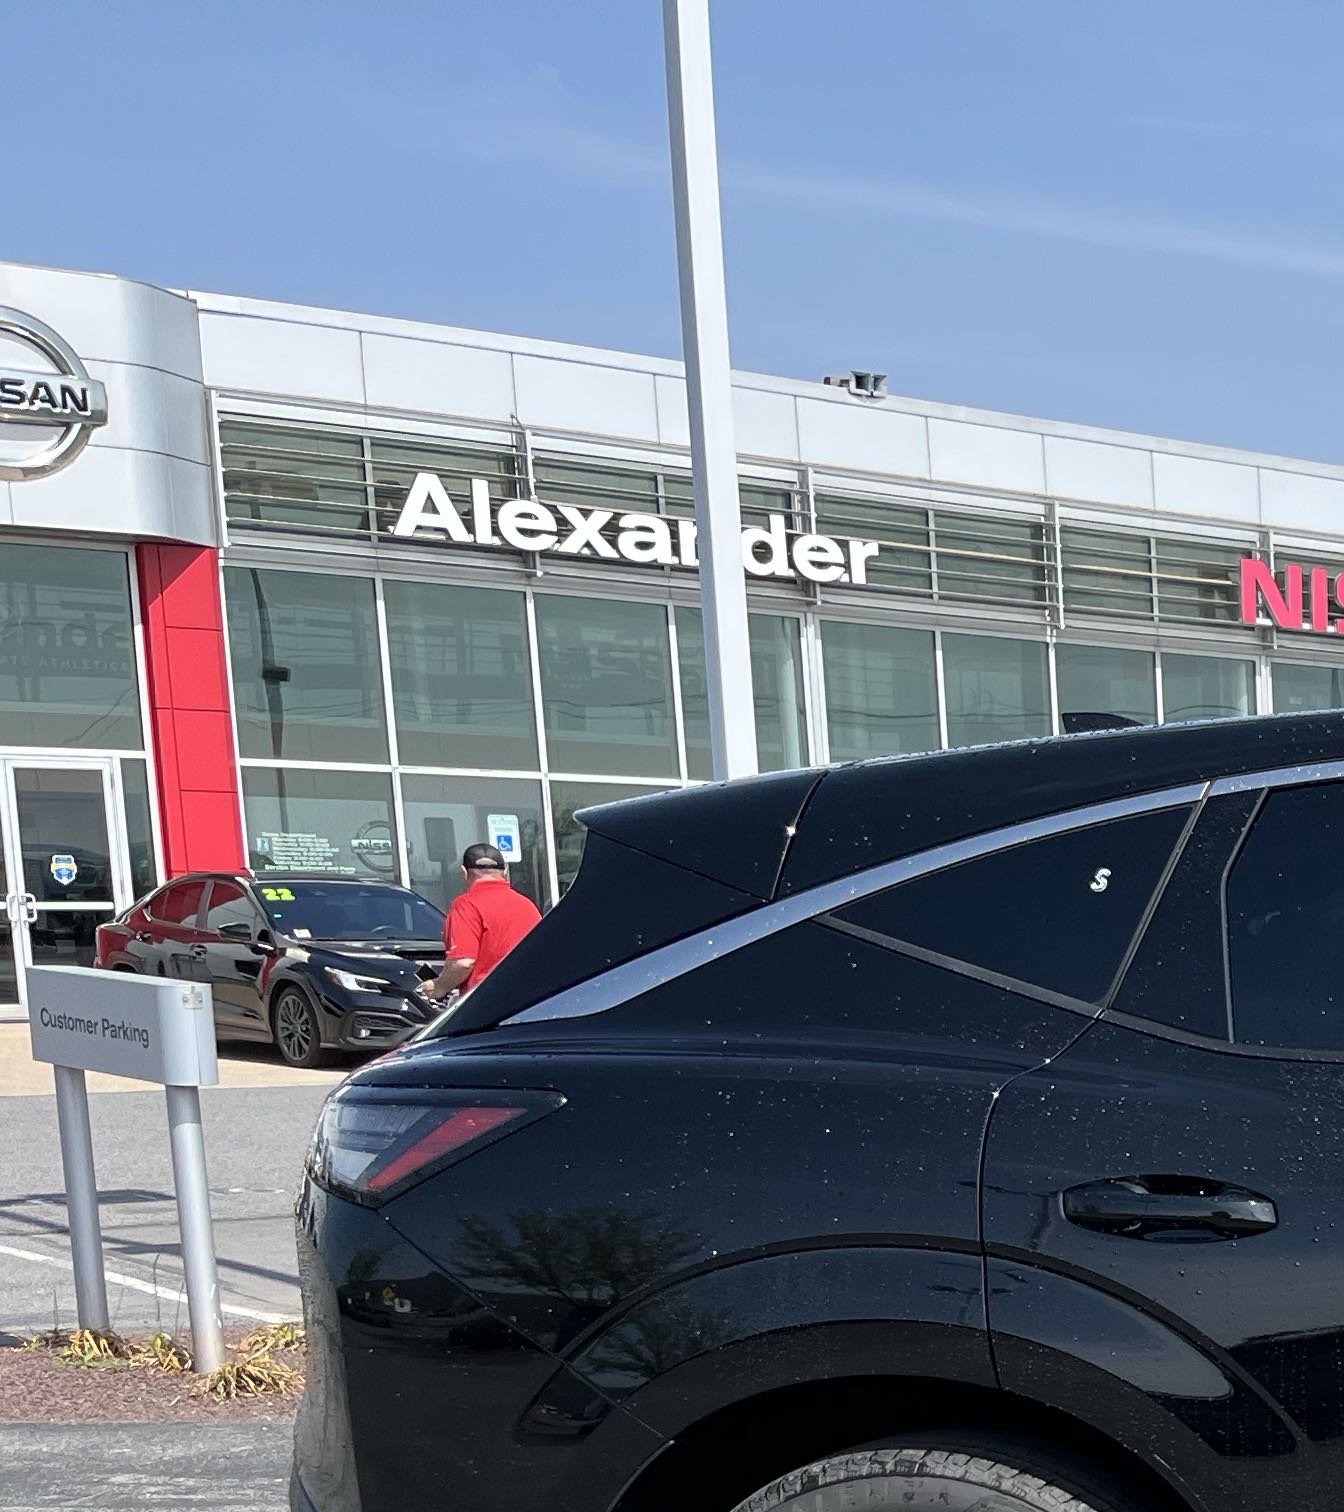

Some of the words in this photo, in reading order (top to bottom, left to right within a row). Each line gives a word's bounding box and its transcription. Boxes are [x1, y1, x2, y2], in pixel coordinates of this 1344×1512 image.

[1090, 868, 1112, 892] S
[262, 888, 296, 901] 22
[40, 1007, 99, 1036] Customer
[102, 1018, 150, 1049] Parking
